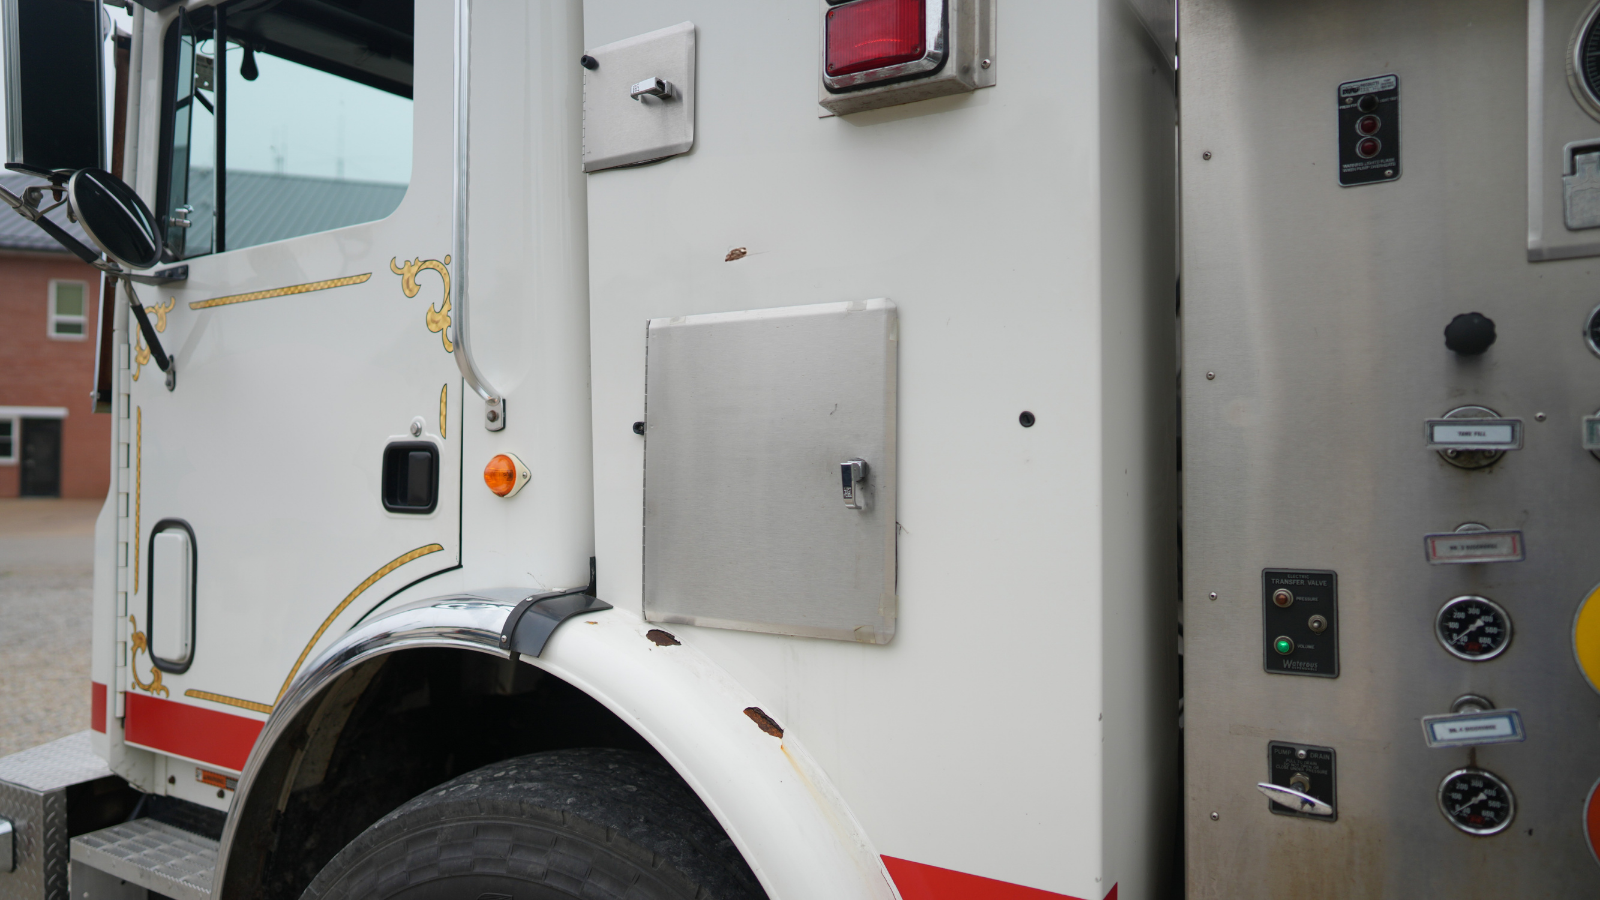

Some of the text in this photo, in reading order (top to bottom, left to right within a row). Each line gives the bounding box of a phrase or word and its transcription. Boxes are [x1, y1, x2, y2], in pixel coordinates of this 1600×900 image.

[1468, 607, 1480, 615] 300
[1485, 626, 1498, 634] 500
[1479, 636, 1492, 644] 600
[1283, 659, 1318, 668] Waterous
[1310, 752, 1330, 760] DRAIN
